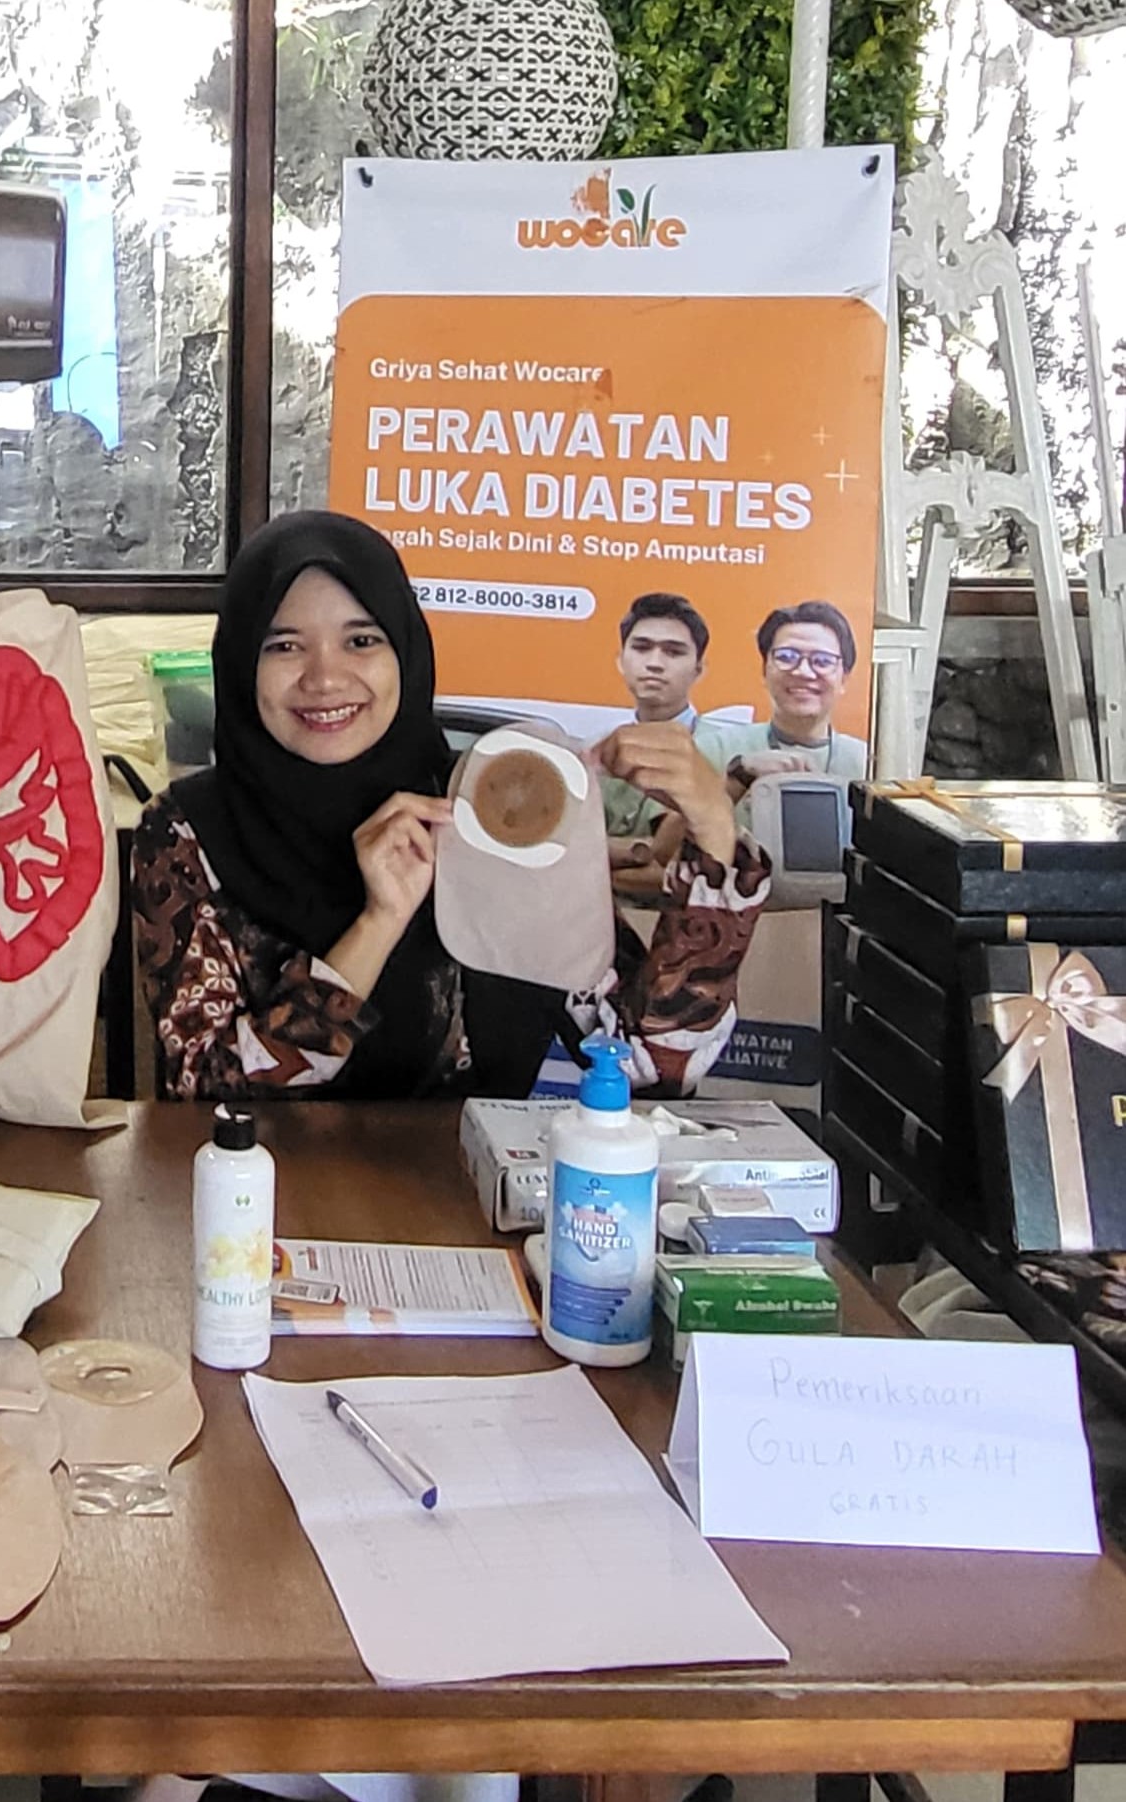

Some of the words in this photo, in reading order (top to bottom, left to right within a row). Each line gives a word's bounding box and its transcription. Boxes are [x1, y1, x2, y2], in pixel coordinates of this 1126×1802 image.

[370, 358, 432, 382] Griya
[438, 359, 507, 381] Sehat
[367, 406, 729, 462] PERAWATAN
[364, 466, 509, 517] LUKA
[524, 473, 812, 530] DIABETES
[439, 528, 502, 551] Sejak
[508, 532, 553, 552] Dini
[559, 534, 576, 554] &
[583, 537, 638, 560] Stop
[644, 538, 765, 567] Amputasi
[435, 587, 577, 611] 812-8000-3814
[729, 1032, 792, 1052] WATAN
[559, 1225, 632, 1250] SANITIZER
[574, 1218, 617, 1236] HAND
[770, 1356, 983, 1406] Pemeriksaan
[747, 1417, 856, 1468] GULA
[893, 1439, 1018, 1477] DARAH
[829, 1490, 930, 1516] GRATIS
